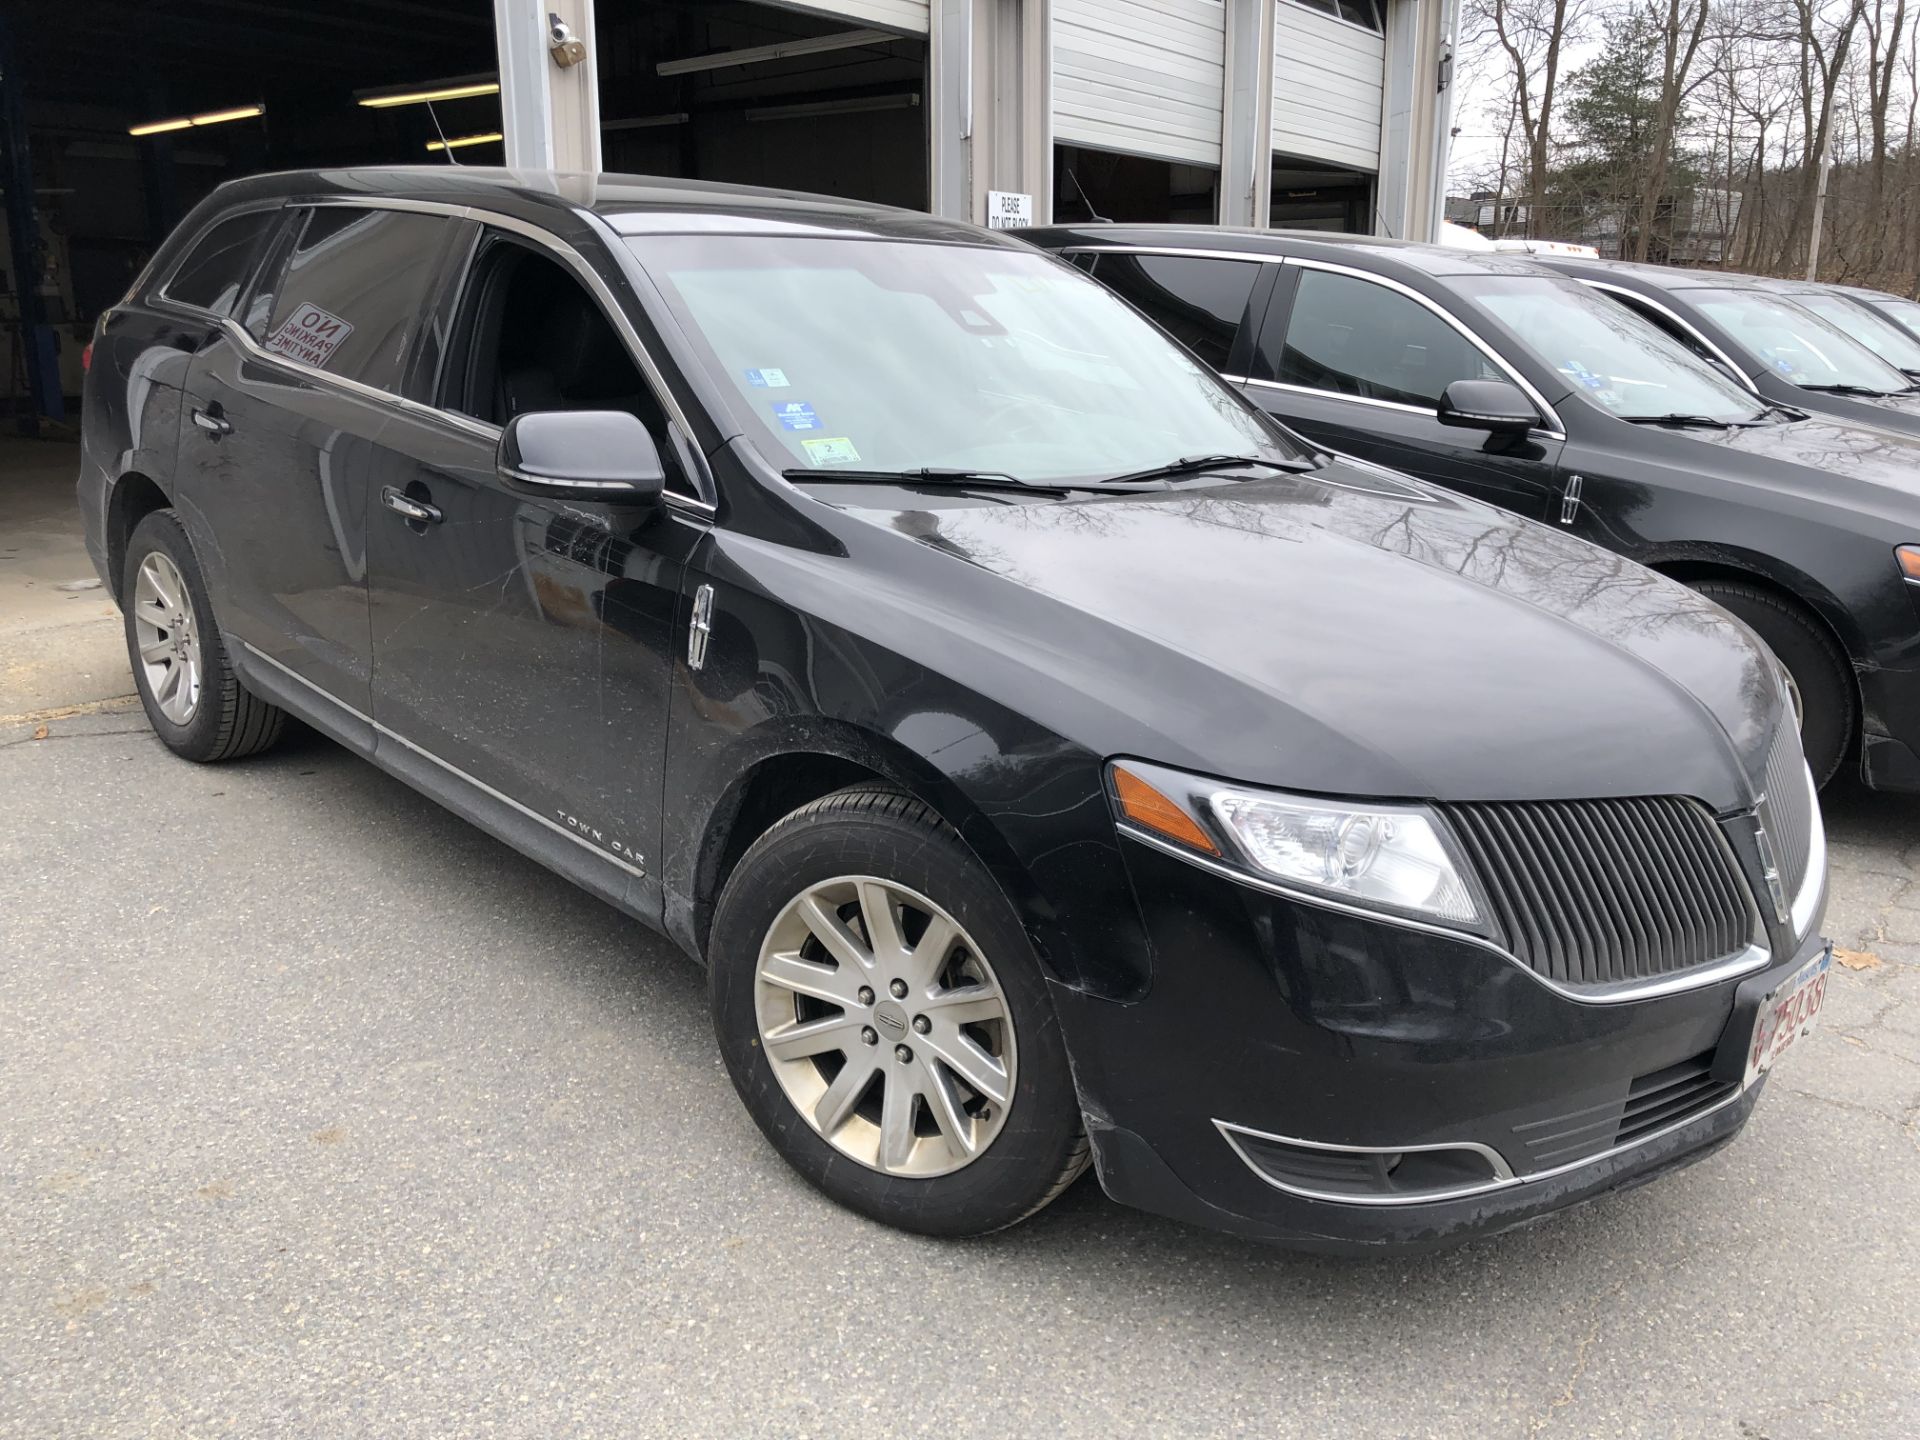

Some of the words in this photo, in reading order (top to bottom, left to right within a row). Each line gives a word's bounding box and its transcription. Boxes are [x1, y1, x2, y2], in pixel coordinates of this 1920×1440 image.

[1001, 196, 1020, 214] PLEASE
[557, 809, 603, 842] TOWN
[611, 841, 645, 865] CAR
